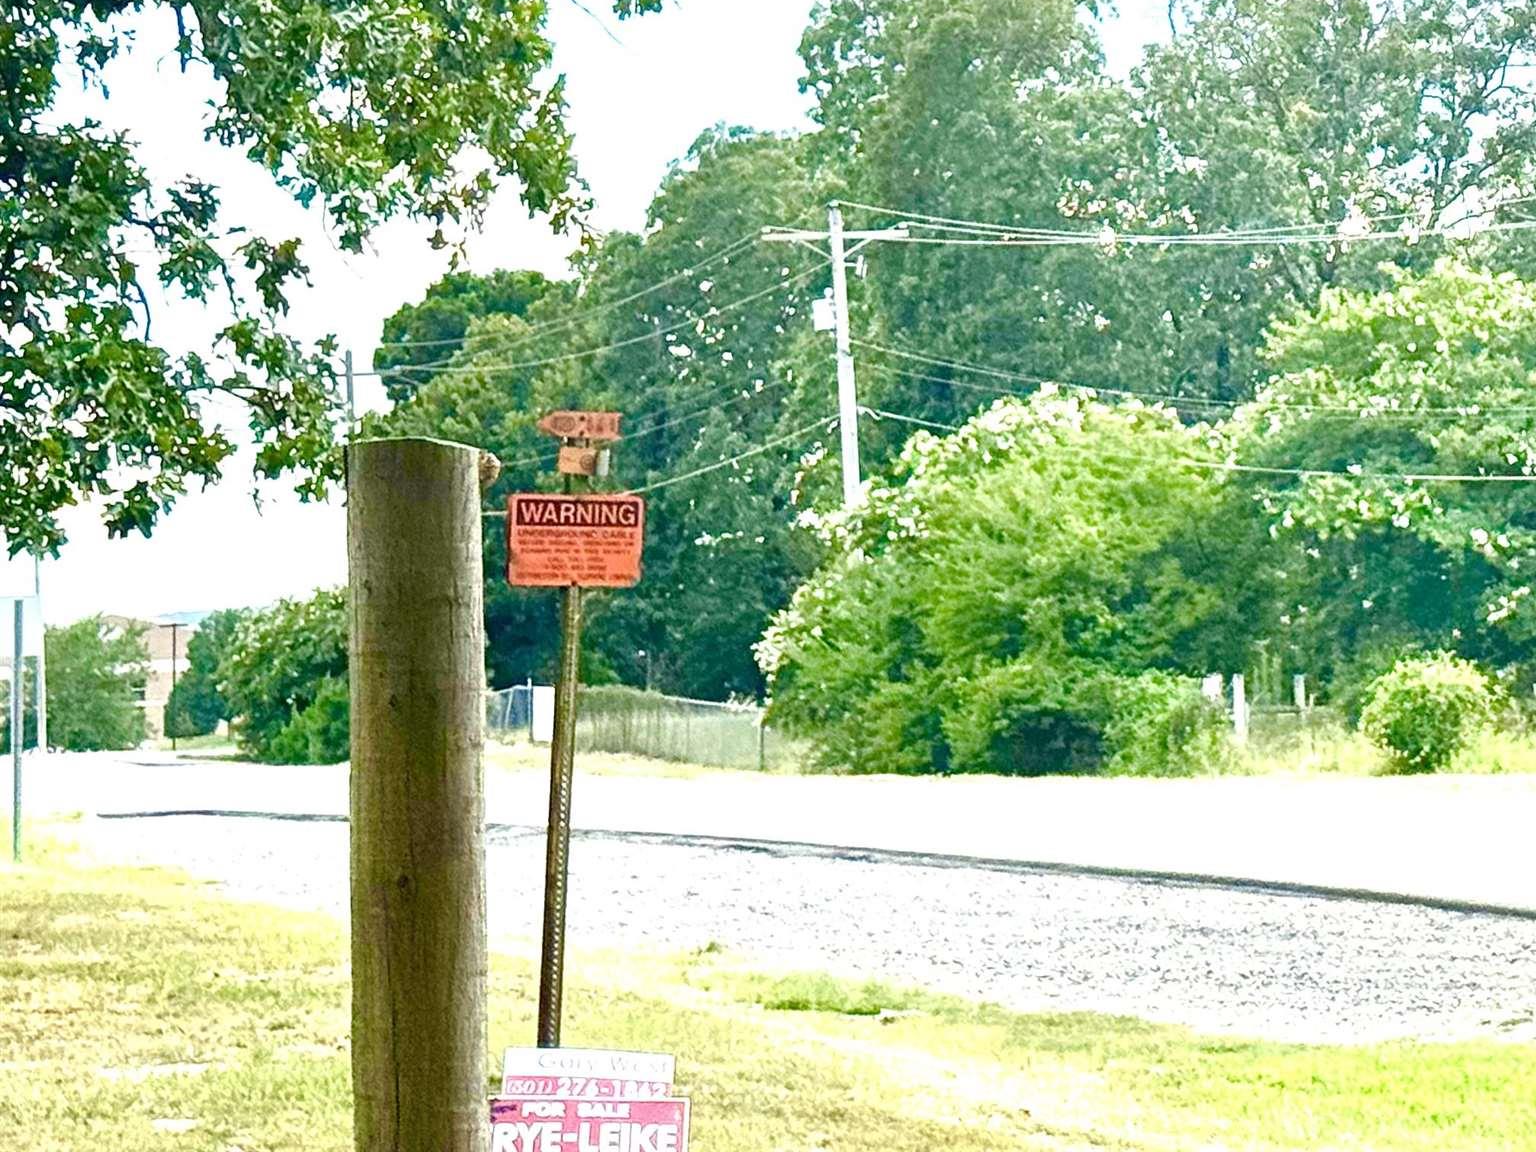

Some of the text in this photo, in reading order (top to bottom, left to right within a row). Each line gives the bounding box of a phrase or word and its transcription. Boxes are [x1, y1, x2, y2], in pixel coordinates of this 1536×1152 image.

[520, 502, 636, 525] WARNING
[521, 1102, 631, 1118] FOR SALE
[489, 1121, 678, 1152] RYE-LEIKE
